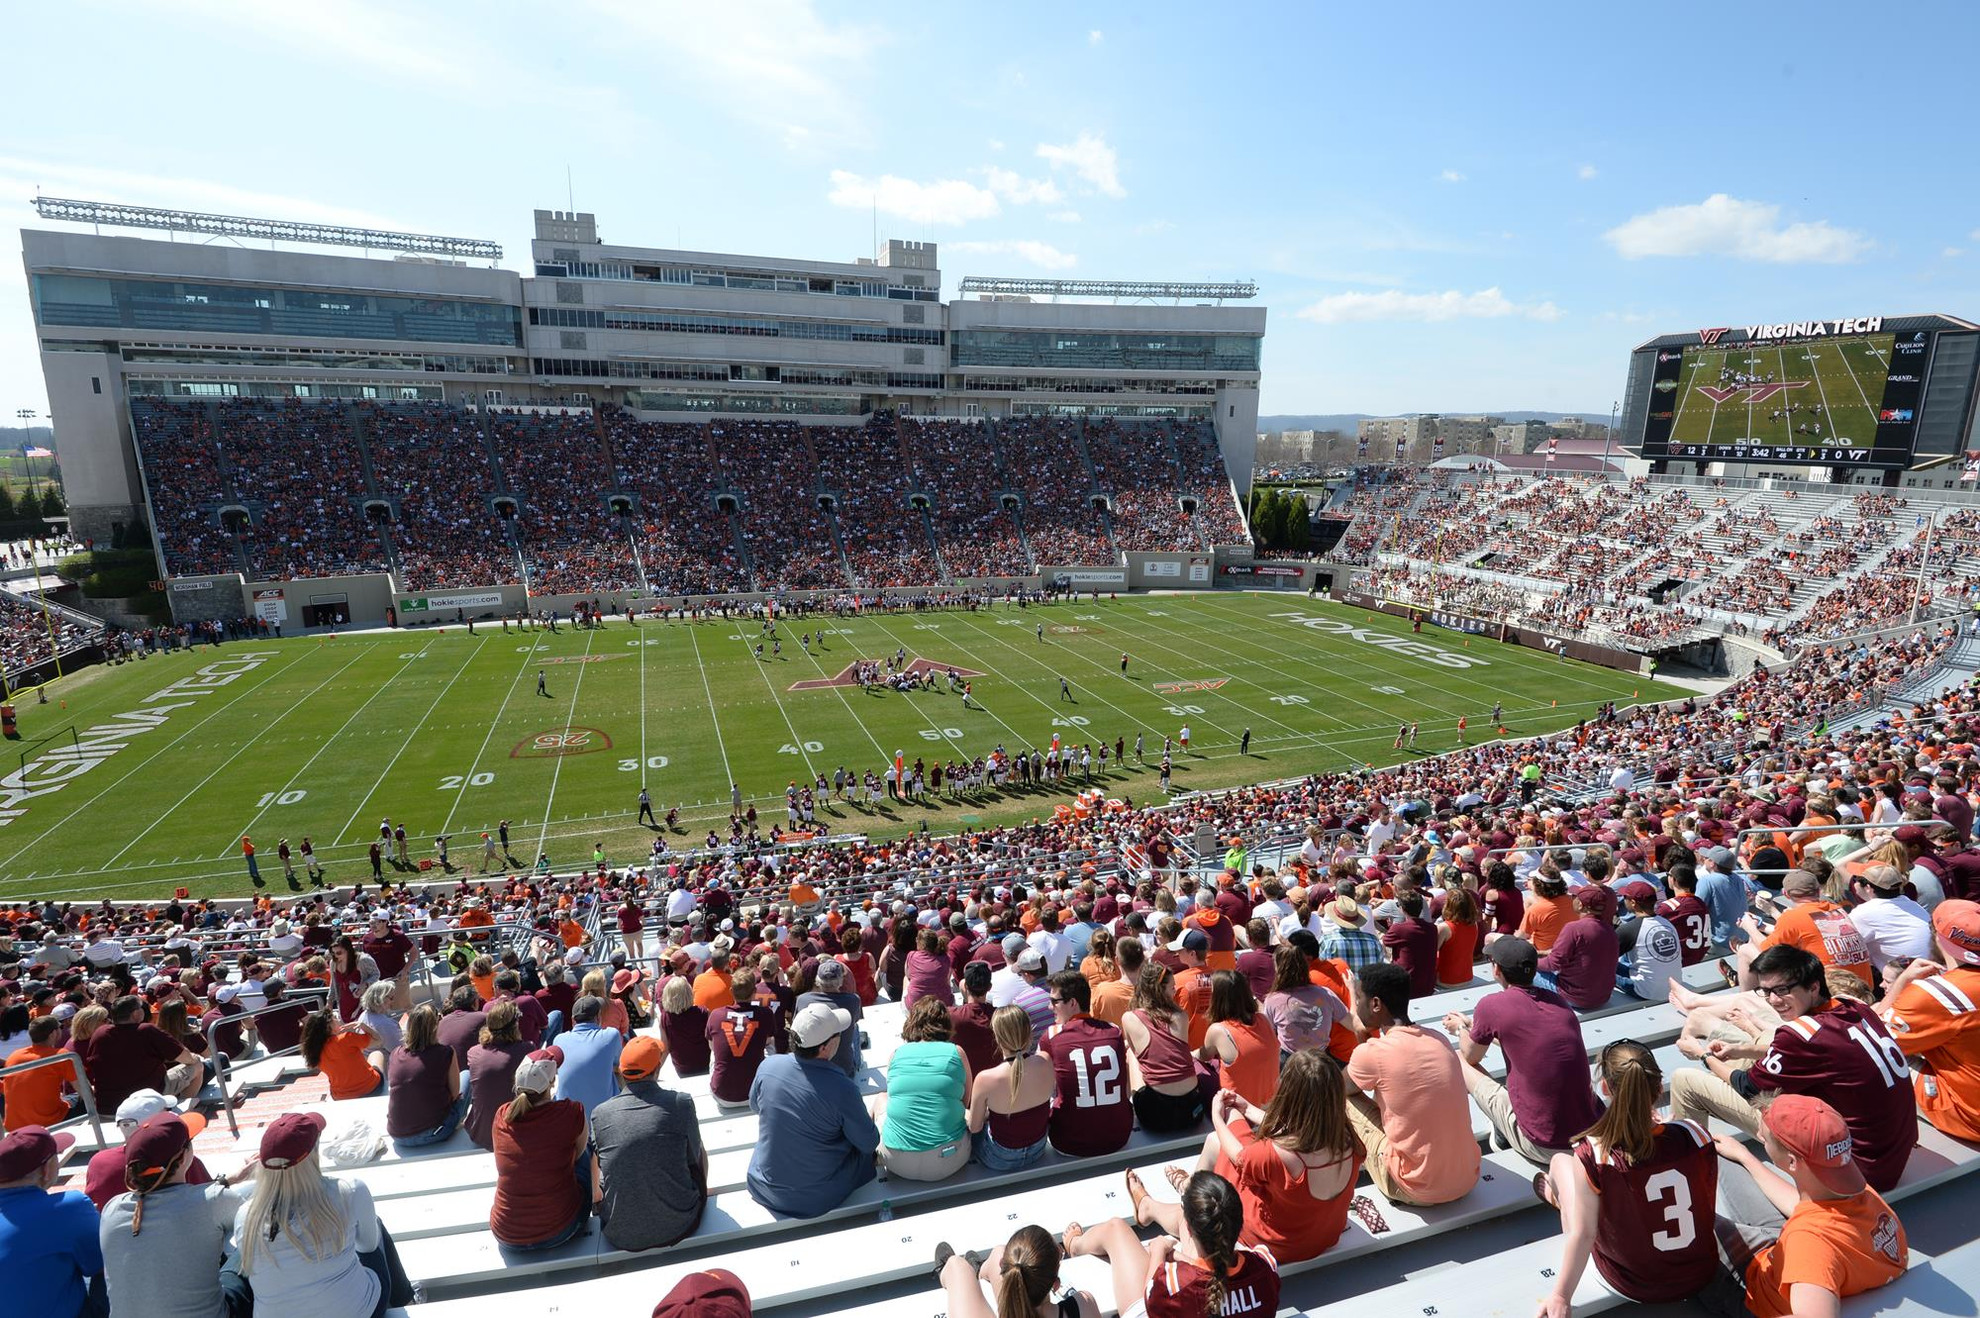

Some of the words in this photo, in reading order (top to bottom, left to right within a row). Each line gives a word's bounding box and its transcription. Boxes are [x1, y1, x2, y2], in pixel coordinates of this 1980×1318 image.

[1699, 327, 1729, 344] VT
[1746, 321, 1826, 340] VIRGINIA
[1833, 317, 1883, 334] TECH
[1736, 438, 1761, 446] 50
[1821, 437, 1852, 446] 40
[1687, 446, 1696, 454] 12
[1752, 449, 1769, 457] 3:42
[1848, 450, 1867, 460] VT
[149, 580, 164, 591] 40
[432, 596, 499, 607] hokiesports.com
[1374, 599, 1388, 609] VT
[1432, 611, 1485, 632] HOKIES
[1267, 612, 1491, 668] HOKIES
[1543, 637, 1562, 649] VT
[140, 650, 281, 704] TECH
[1270, 695, 1309, 706] 20
[1162, 705, 1205, 716] 30
[1052, 716, 1091, 726] 40
[533, 731, 592, 749] 25
[918, 728, 964, 740] 50
[777, 741, 824, 754] 40
[618, 756, 668, 771] 30
[437, 772, 495, 790] 20
[255, 790, 307, 807] 10
[1686, 914, 1712, 950] 34
[727, 1011, 754, 1032] T
[721, 1021, 759, 1057] V
[1848, 1018, 1909, 1088] 16
[1760, 1046, 1784, 1076] 16
[1068, 1044, 1122, 1108] 12
[1645, 1168, 1696, 1252] 3
[901, 1236, 912, 1244] 20
[1540, 1269, 1555, 1278] 28
[1220, 1286, 1261, 1317] HALL
[1423, 1306, 1438, 1317] 26
